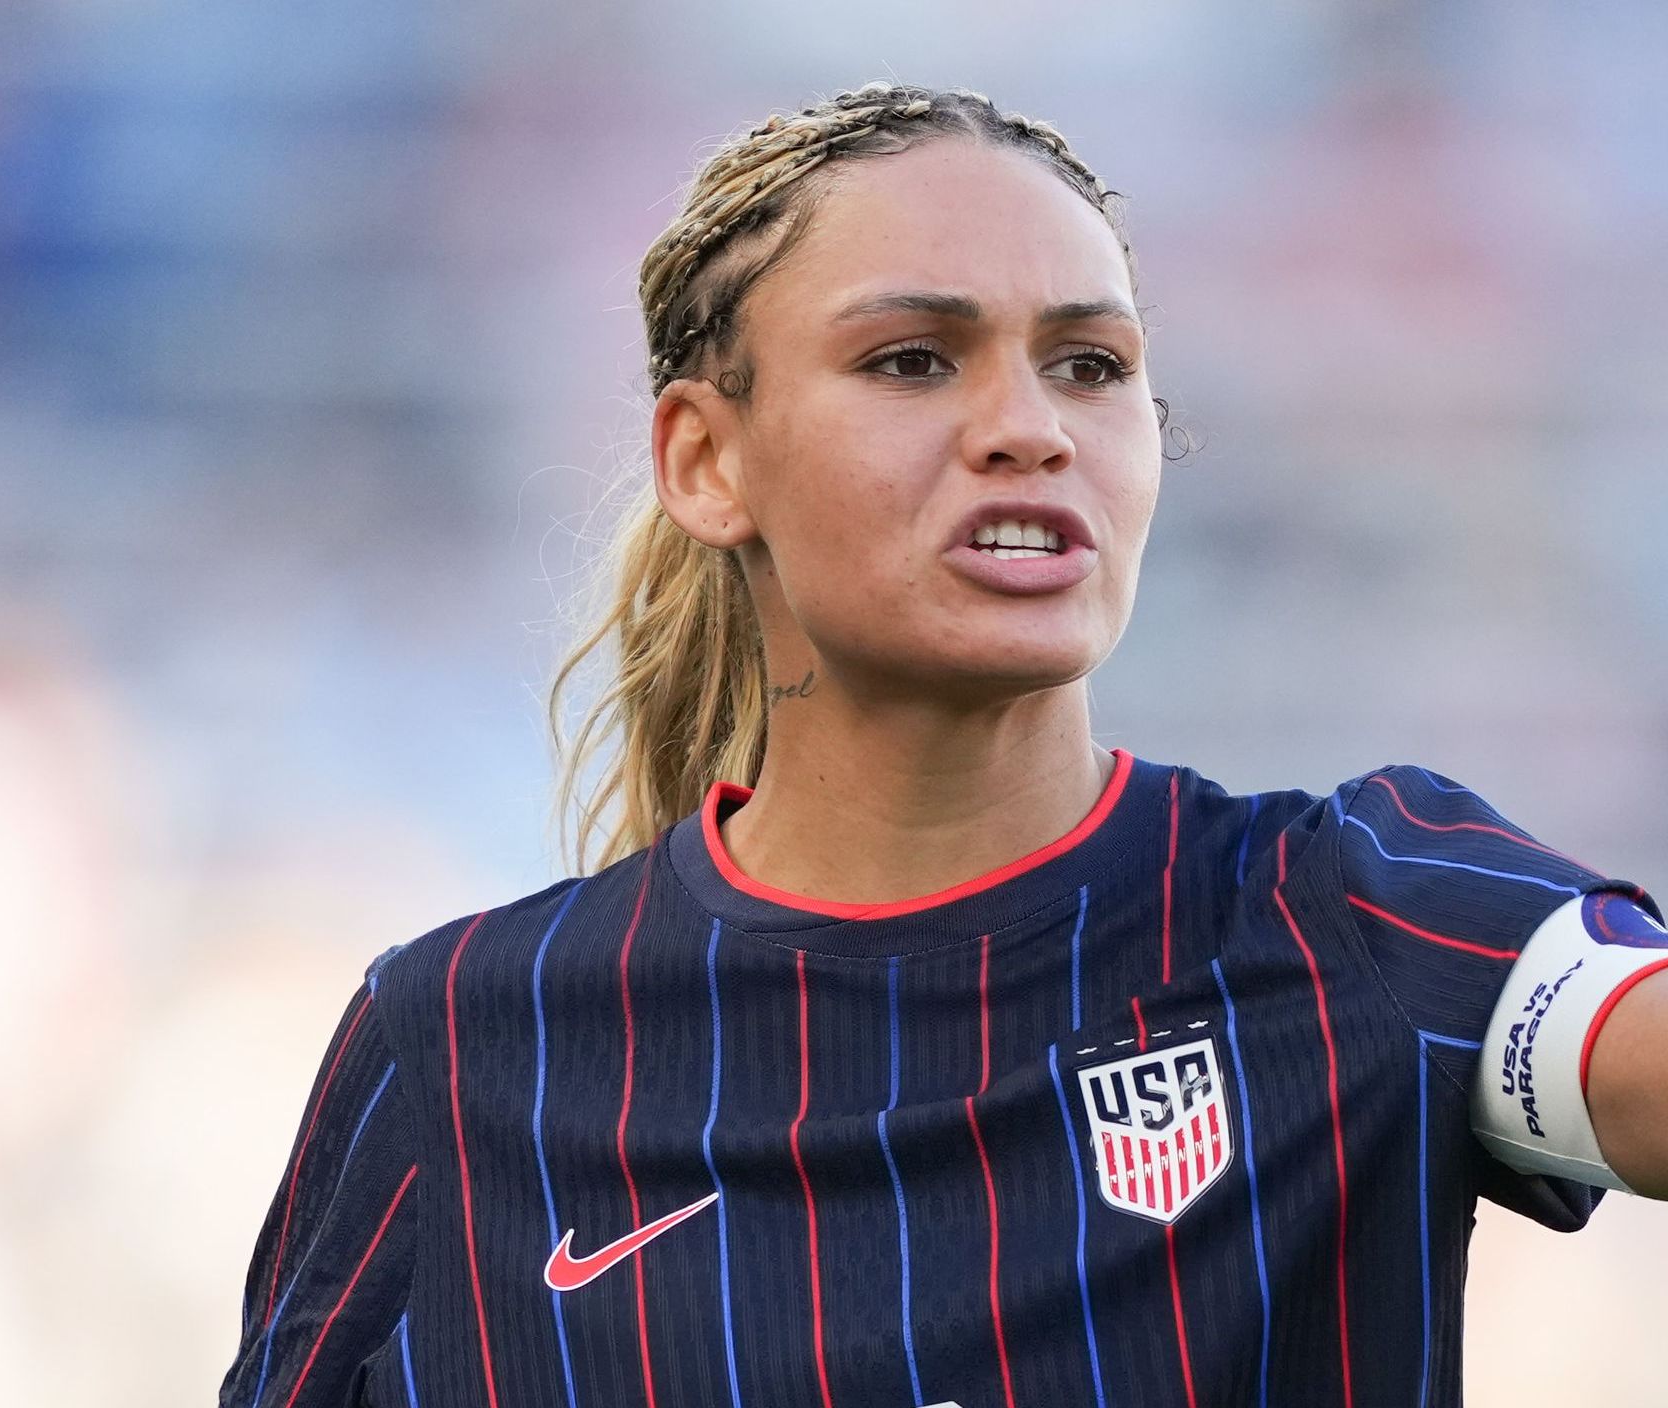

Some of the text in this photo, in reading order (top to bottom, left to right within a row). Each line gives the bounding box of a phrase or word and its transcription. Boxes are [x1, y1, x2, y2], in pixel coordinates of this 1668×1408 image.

[1502, 1022, 1526, 1096] USA
[1519, 958, 1584, 1138] PARAGUAY
[1089, 1050, 1213, 1132] USA
